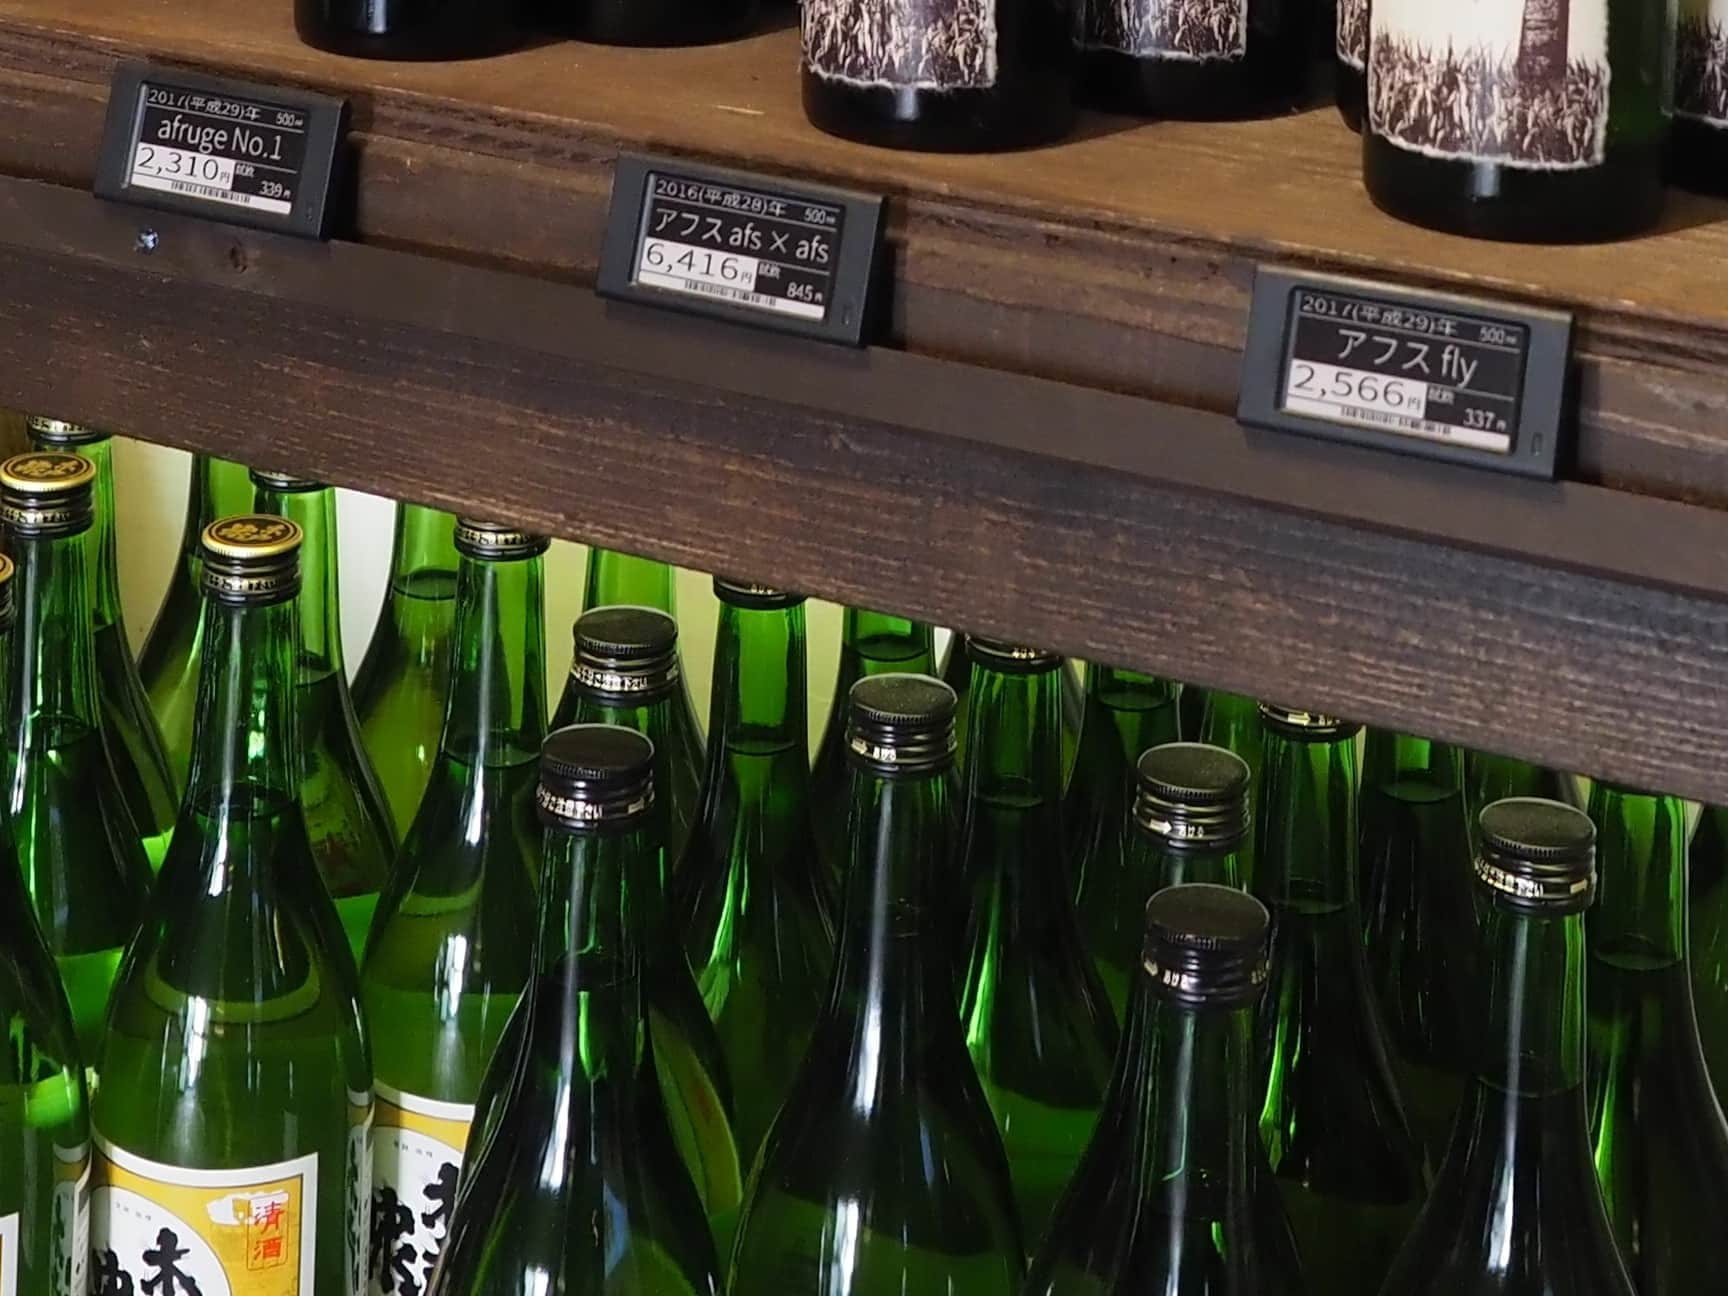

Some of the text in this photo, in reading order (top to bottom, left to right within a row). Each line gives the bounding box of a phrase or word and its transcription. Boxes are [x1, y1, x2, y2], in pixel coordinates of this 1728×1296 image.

[157, 114, 282, 161] afruge No.1
[138, 146, 230, 183] 2,310円
[655, 207, 829, 264] アフス afs afs
[646, 242, 752, 285] 6,416円
[1337, 328, 1479, 389] アフス fly
[1293, 363, 1421, 412] 2,566円
[248, 1198, 284, 1262] 清酒
